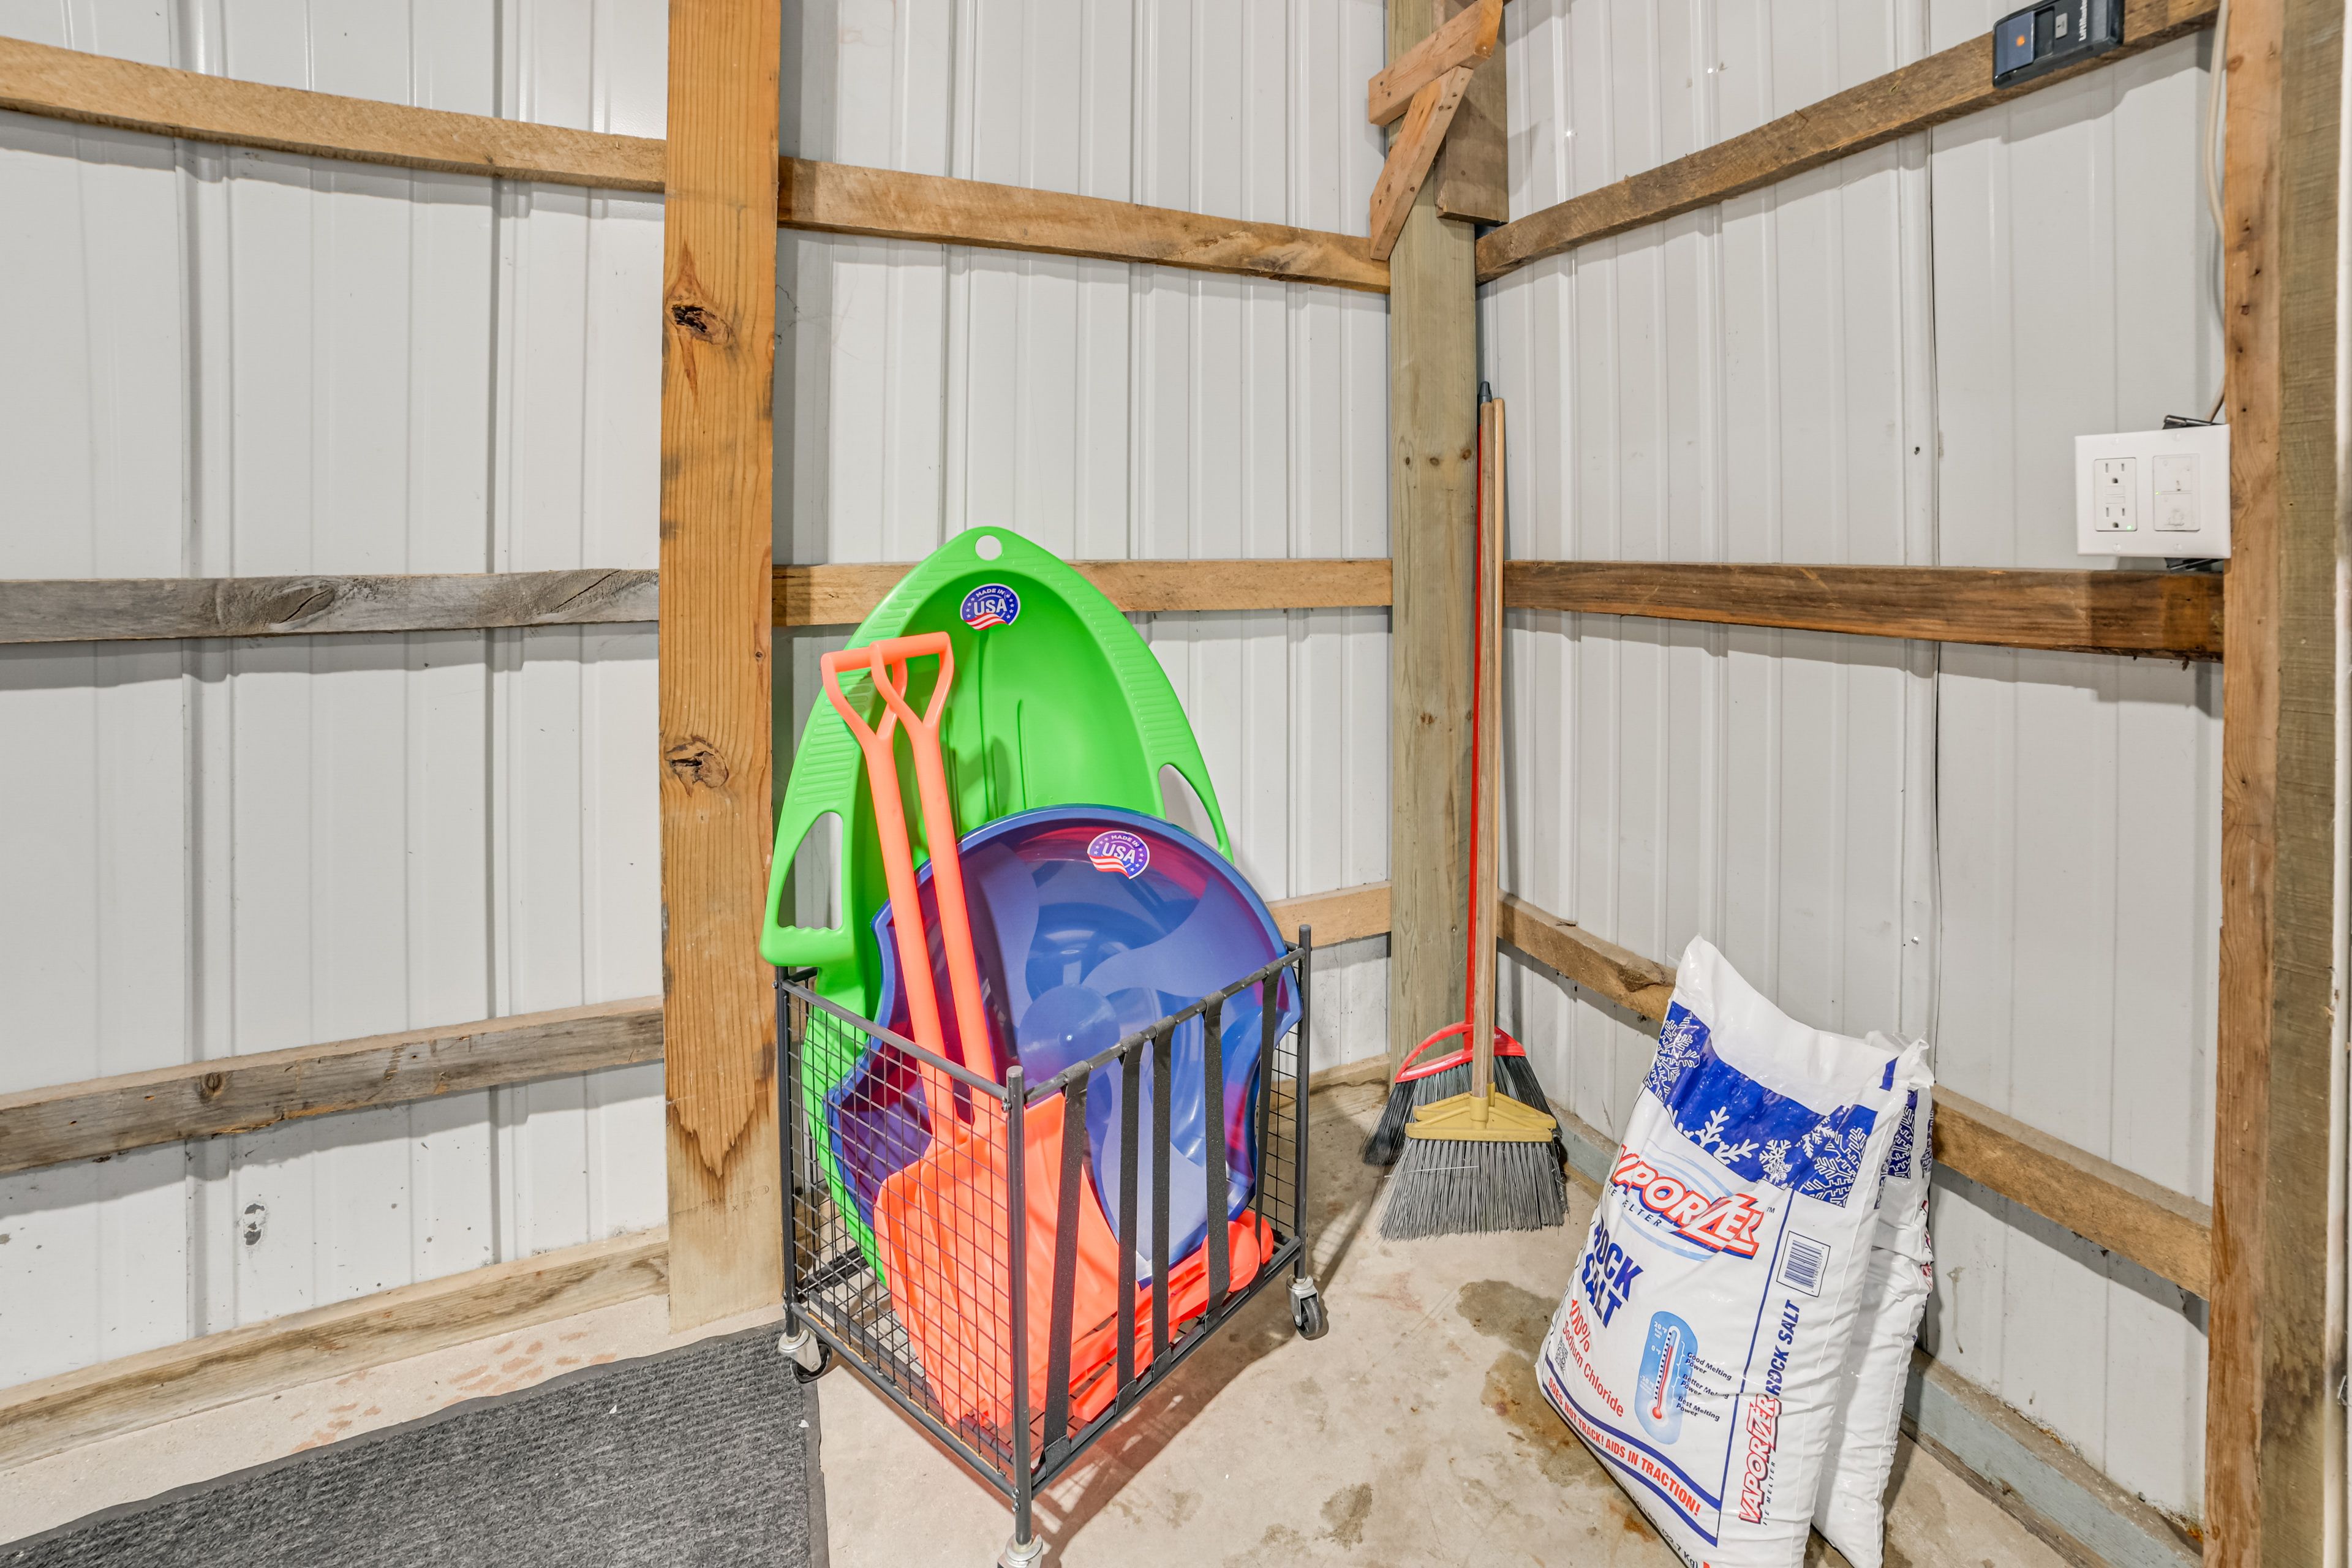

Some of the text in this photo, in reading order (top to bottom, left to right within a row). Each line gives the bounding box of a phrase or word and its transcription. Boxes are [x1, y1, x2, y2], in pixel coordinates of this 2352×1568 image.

[2079, 0, 2087, 41] LiftMaste
[973, 598, 1008, 616] USA
[976, 588, 997, 598] MADE
[1102, 842, 1136, 864] USA
[1623, 1200, 1664, 1227] ELTER
[1594, 1213, 1644, 1302] ROCK
[1581, 1253, 1623, 1329] SALT
[1570, 1299, 1591, 1352] 100%
[1765, 1298, 1800, 1396] ROCK SALT
[1685, 1359, 1707, 1374] Power
[1687, 1352, 1732, 1381] Good Melting
[1584, 1363, 1624, 1417] Chloride
[1681, 1381, 1702, 1395] Power
[1683, 1374, 1703, 1389] Better
[1676, 1403, 1698, 1417] Power
[1678, 1396, 1721, 1422] Best Melting
[1548, 1377, 1562, 1405] DOES
[1565, 1402, 1577, 1423] NOT
[1578, 1419, 1604, 1446] TRACK!
[1605, 1438, 1626, 1458] AIDS
[1627, 1450, 1639, 1466] IN
[1642, 1458, 1701, 1516] TRACTION!
[1738, 1393, 1782, 1525] VAPORIZER
[1766, 1461, 1776, 1504] MELTER
